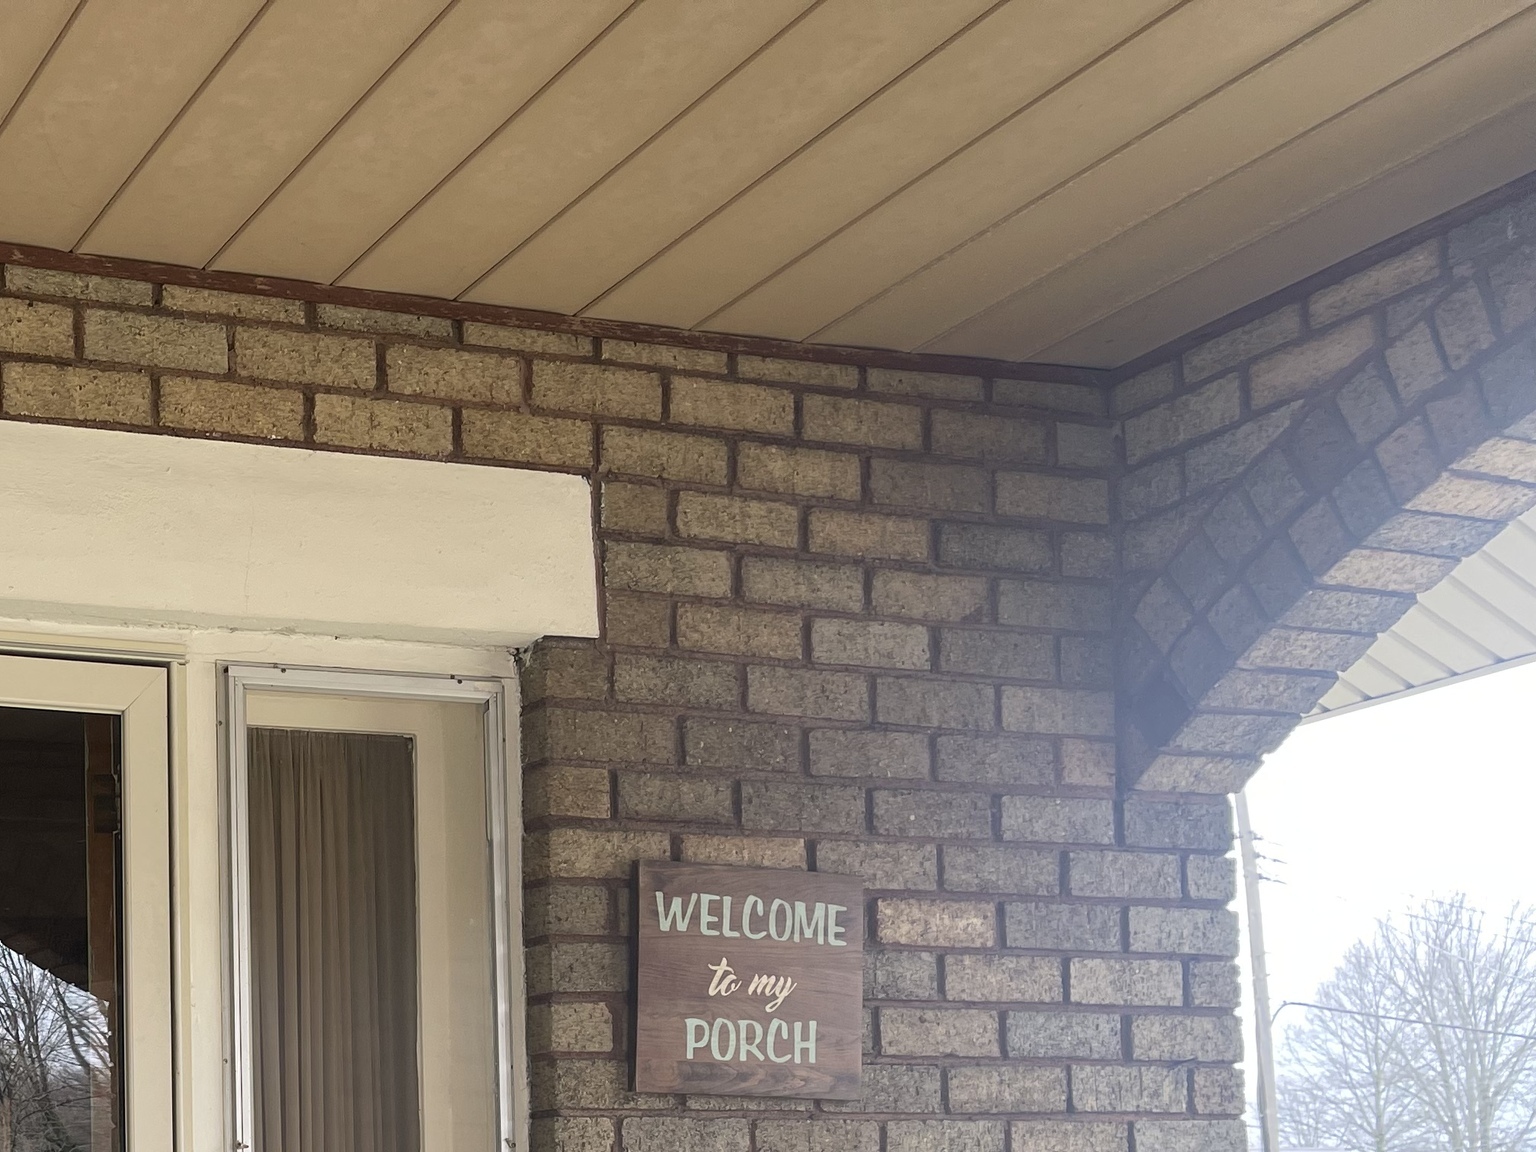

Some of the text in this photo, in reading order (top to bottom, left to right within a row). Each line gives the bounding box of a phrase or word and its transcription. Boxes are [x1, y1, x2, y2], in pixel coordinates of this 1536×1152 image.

[655, 891, 848, 947] WELCOME
[708, 957, 797, 1013] to my
[685, 1017, 817, 1064] PORCH
